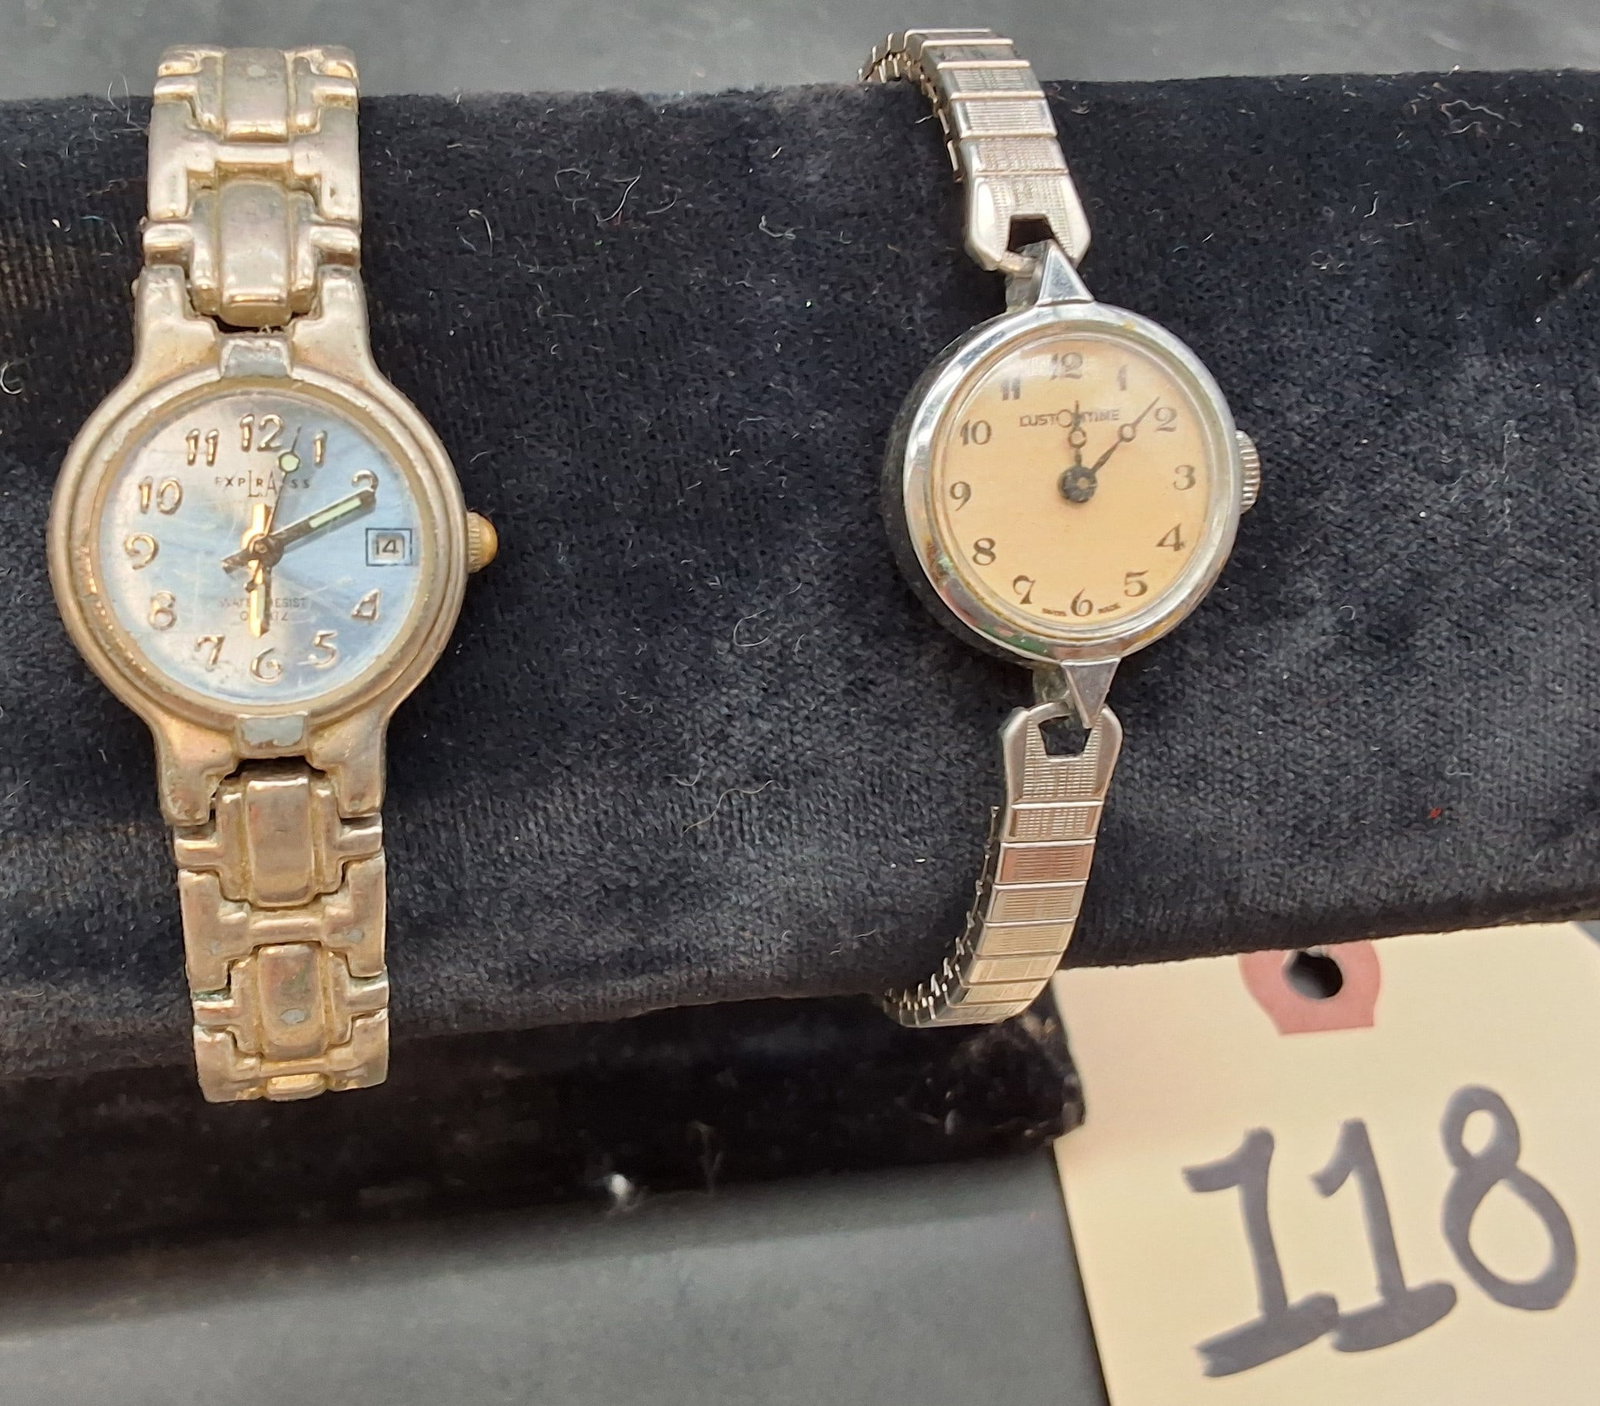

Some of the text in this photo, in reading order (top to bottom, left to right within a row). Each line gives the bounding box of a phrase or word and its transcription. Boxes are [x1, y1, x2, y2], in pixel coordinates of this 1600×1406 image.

[1050, 351, 1083, 380] 12
[1116, 364, 1128, 391] 1
[1001, 374, 1021, 401] 11
[239, 413, 285, 452] 12
[960, 419, 993, 446] 10
[1154, 407, 1178, 432] 2
[185, 428, 219, 467] 11
[313, 430, 328, 467] 1
[1173, 464, 1197, 491] 3
[138, 476, 183, 515] 10
[950, 481, 972, 511] 9
[124, 533, 159, 570] 9
[972, 537, 996, 566] 8
[1155, 523, 1187, 552] 4
[1012, 574, 1036, 605] 7
[1124, 570, 1149, 597] 5
[149, 591, 176, 630] 8
[351, 588, 381, 622] 4
[1070, 587, 1093, 617] 6
[194, 633, 226, 671] 7
[307, 629, 338, 668] 5
[252, 648, 283, 684] 6
[1181, 1084, 1578, 1378] 118
